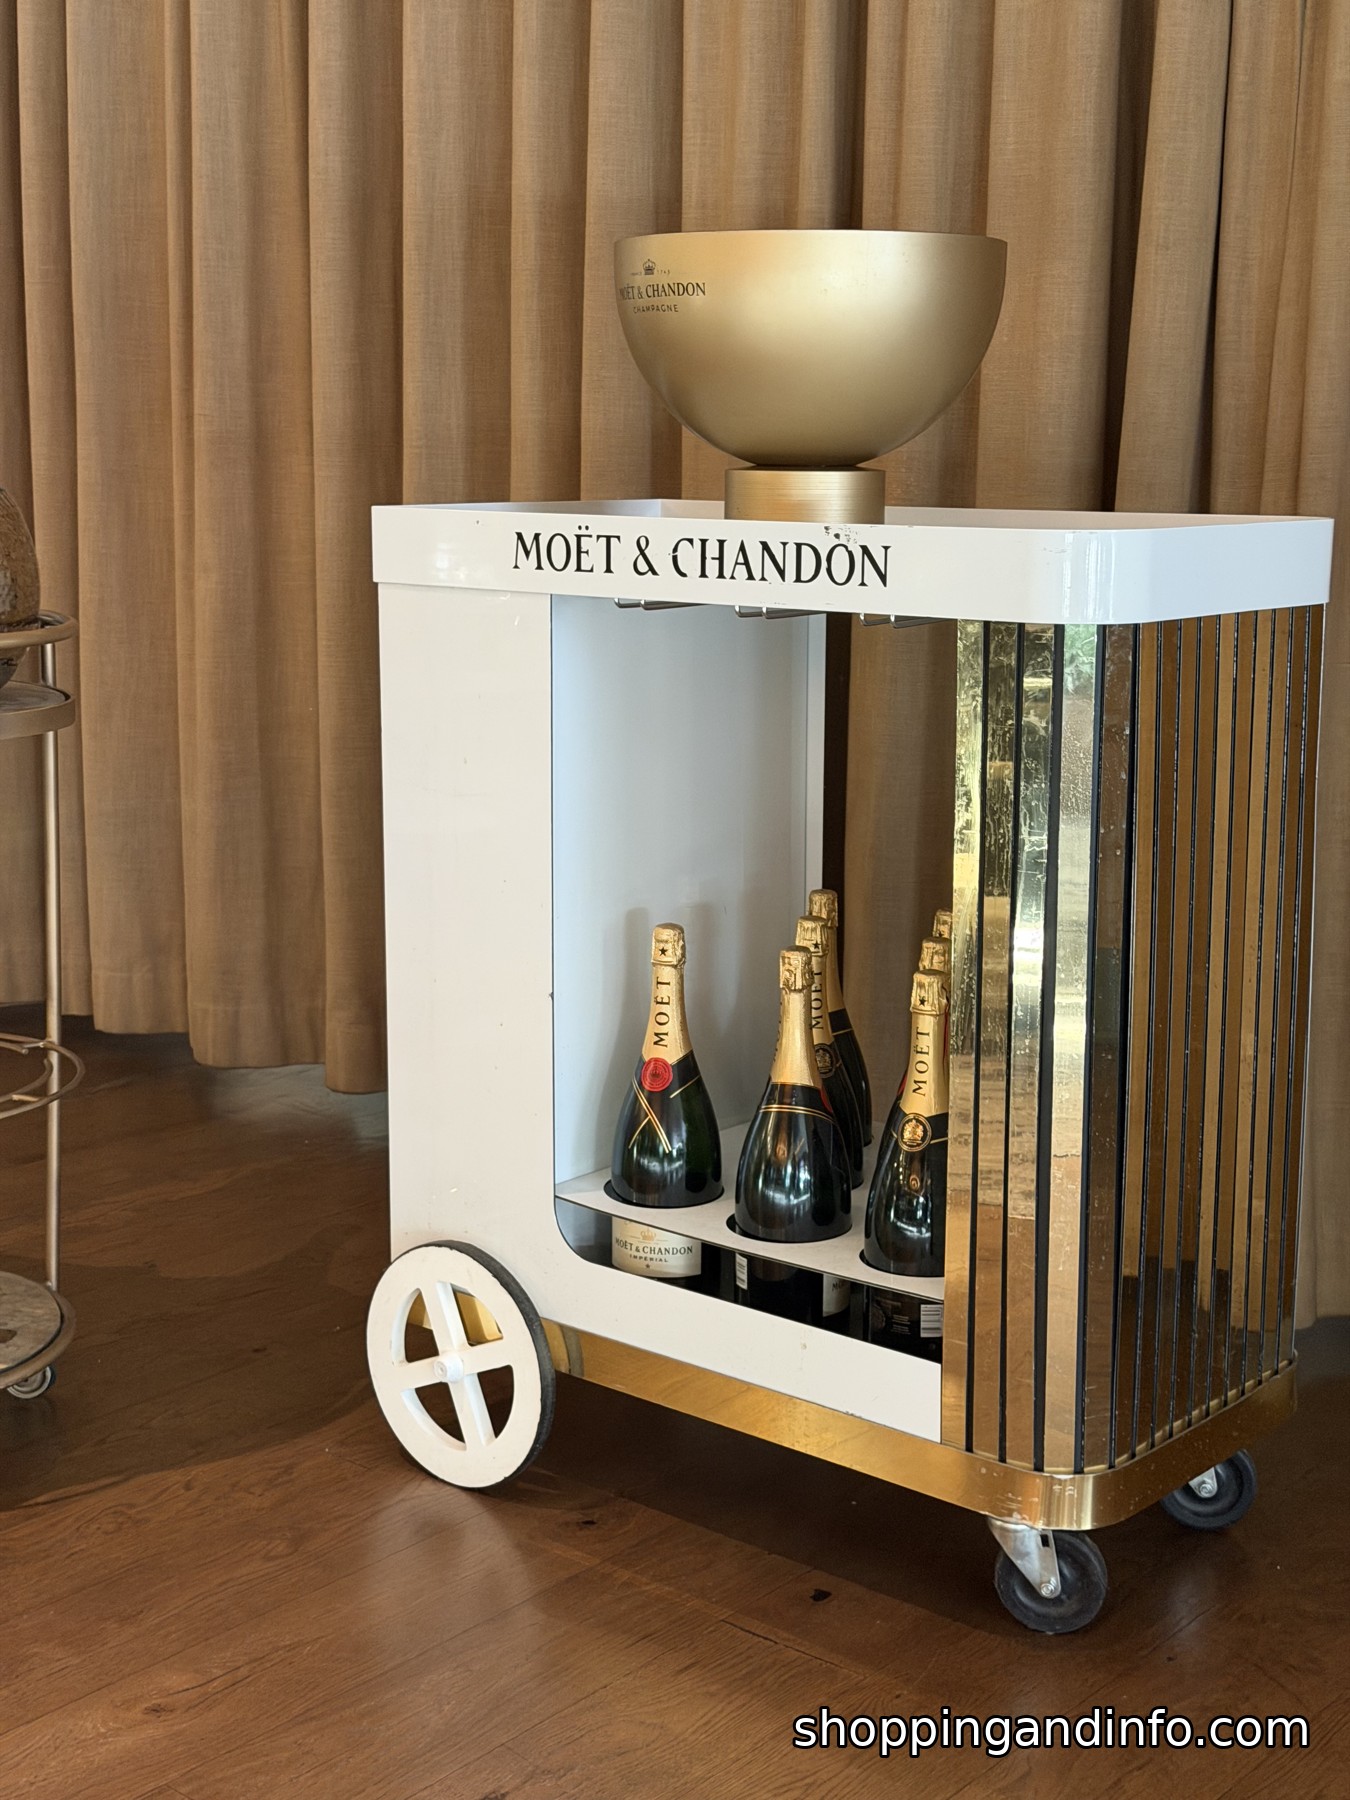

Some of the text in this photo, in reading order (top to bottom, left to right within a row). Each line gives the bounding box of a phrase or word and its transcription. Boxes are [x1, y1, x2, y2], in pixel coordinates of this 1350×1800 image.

[633, 304, 679, 314] CHAMPAGNE
[636, 285, 644, 300] &
[645, 282, 706, 299] CHANDON
[512, 525, 892, 588] MOËT & CHANDON
[653, 976, 671, 1048] MOËT
[912, 1026, 930, 1097] MOËT
[635, 1245, 641, 1253] &
[642, 1245, 693, 1256] CHANDON
